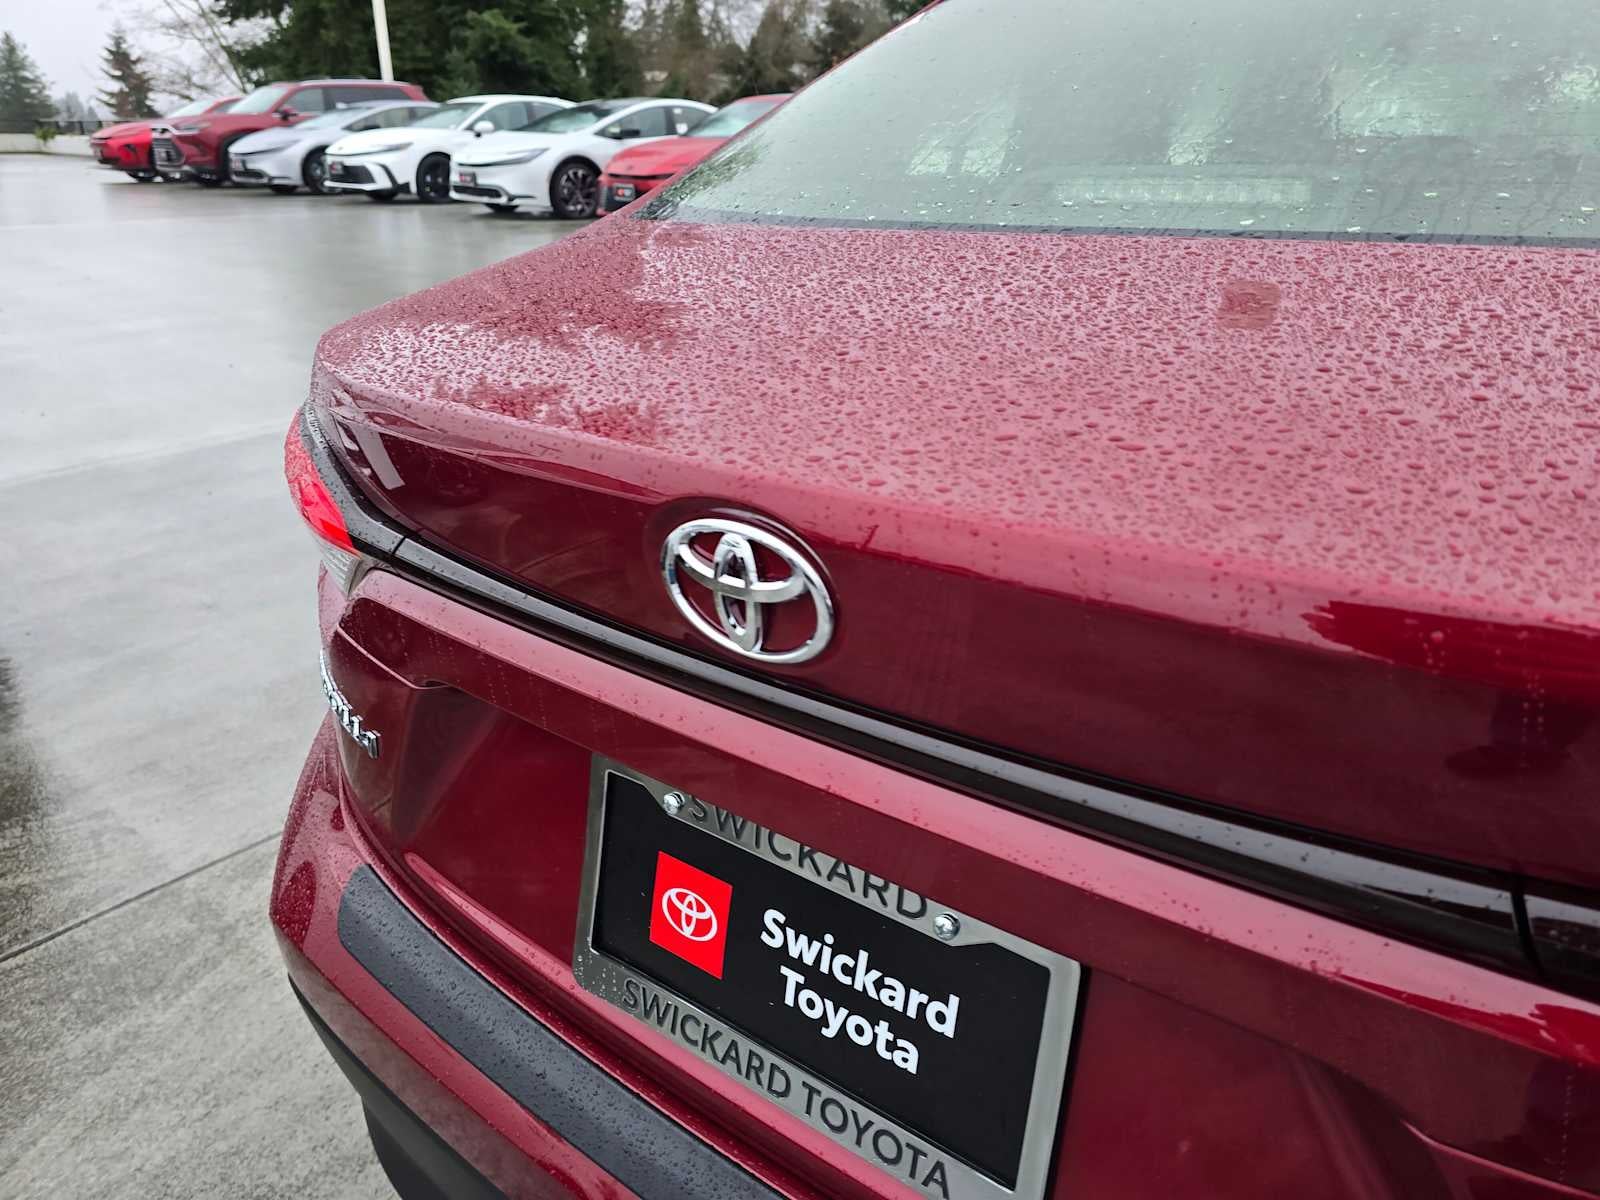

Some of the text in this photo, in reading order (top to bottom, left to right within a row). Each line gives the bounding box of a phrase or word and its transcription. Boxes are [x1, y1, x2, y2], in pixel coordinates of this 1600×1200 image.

[688, 795, 928, 919] SWICKARD
[760, 908, 960, 1038] Swickard
[780, 965, 919, 1075] Toyota
[623, 978, 950, 1200] SWICKARD TOYOTA
